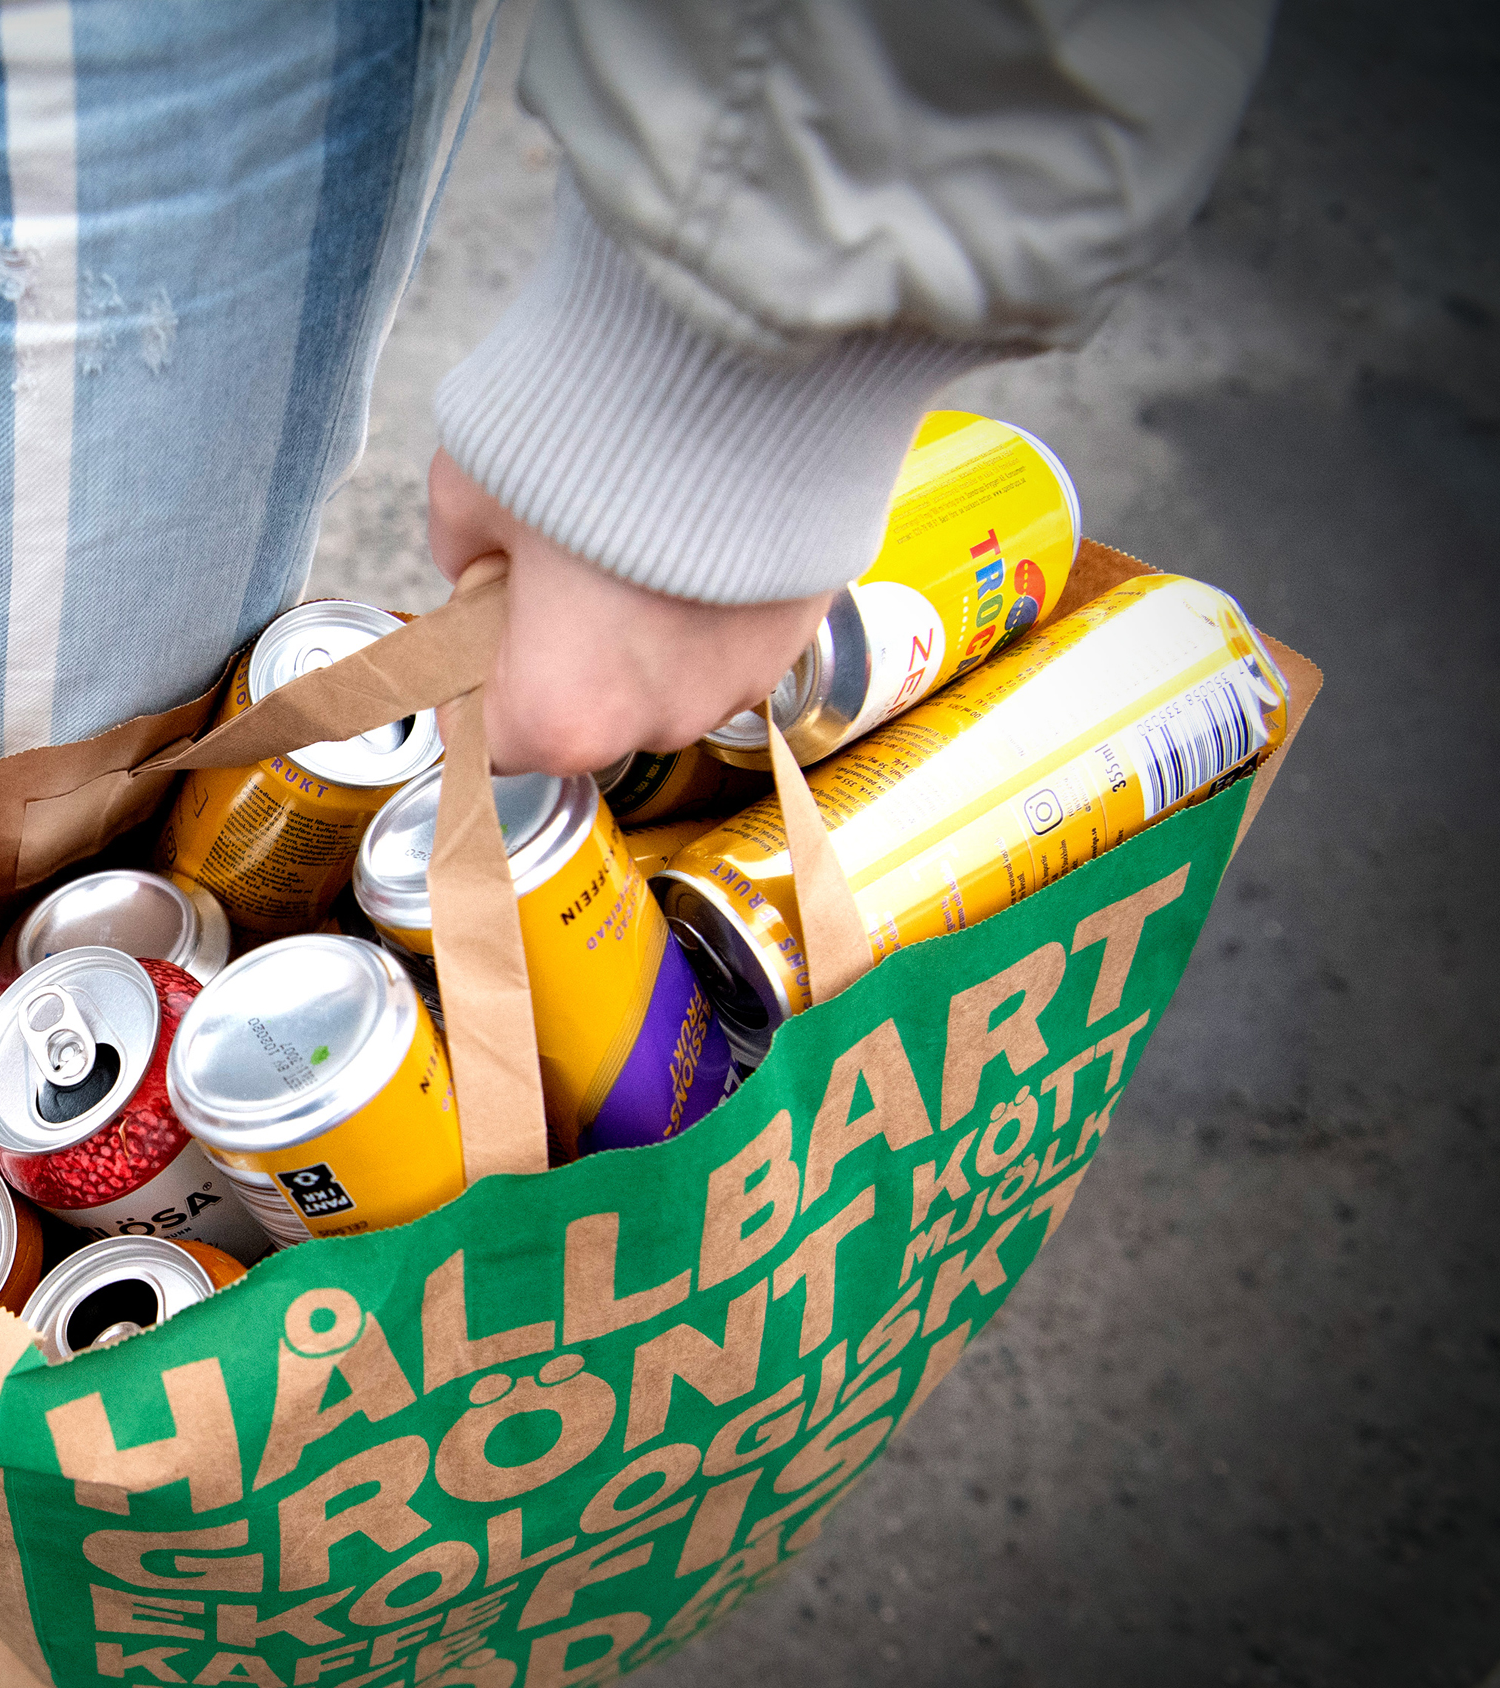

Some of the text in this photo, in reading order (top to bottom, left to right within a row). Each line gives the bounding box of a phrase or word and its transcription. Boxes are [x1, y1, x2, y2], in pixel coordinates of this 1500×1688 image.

[1183, 671, 1230, 706] 350058
[1134, 701, 1182, 736] 335030
[270, 757, 329, 798] RUKT
[841, 776, 857, 789] 355
[1095, 743, 1127, 792] 355 ml
[708, 860, 777, 924] FRUKT
[951, 892, 962, 907] och
[246, 1016, 280, 1057] 102020
[667, 983, 705, 1093] FRUKT
[662, 999, 713, 1137] ASSIONS-
[910, 1008, 1150, 1232] KÖTT
[46, 861, 1191, 1516] HÅLLBART
[301, 1189, 327, 1202] KR
[303, 1194, 349, 1213] PANT
[898, 1085, 1125, 1290] MJÖLK
[82, 1184, 875, 1594] GRÖNT
[95, 1581, 521, 1688] KAFFE
